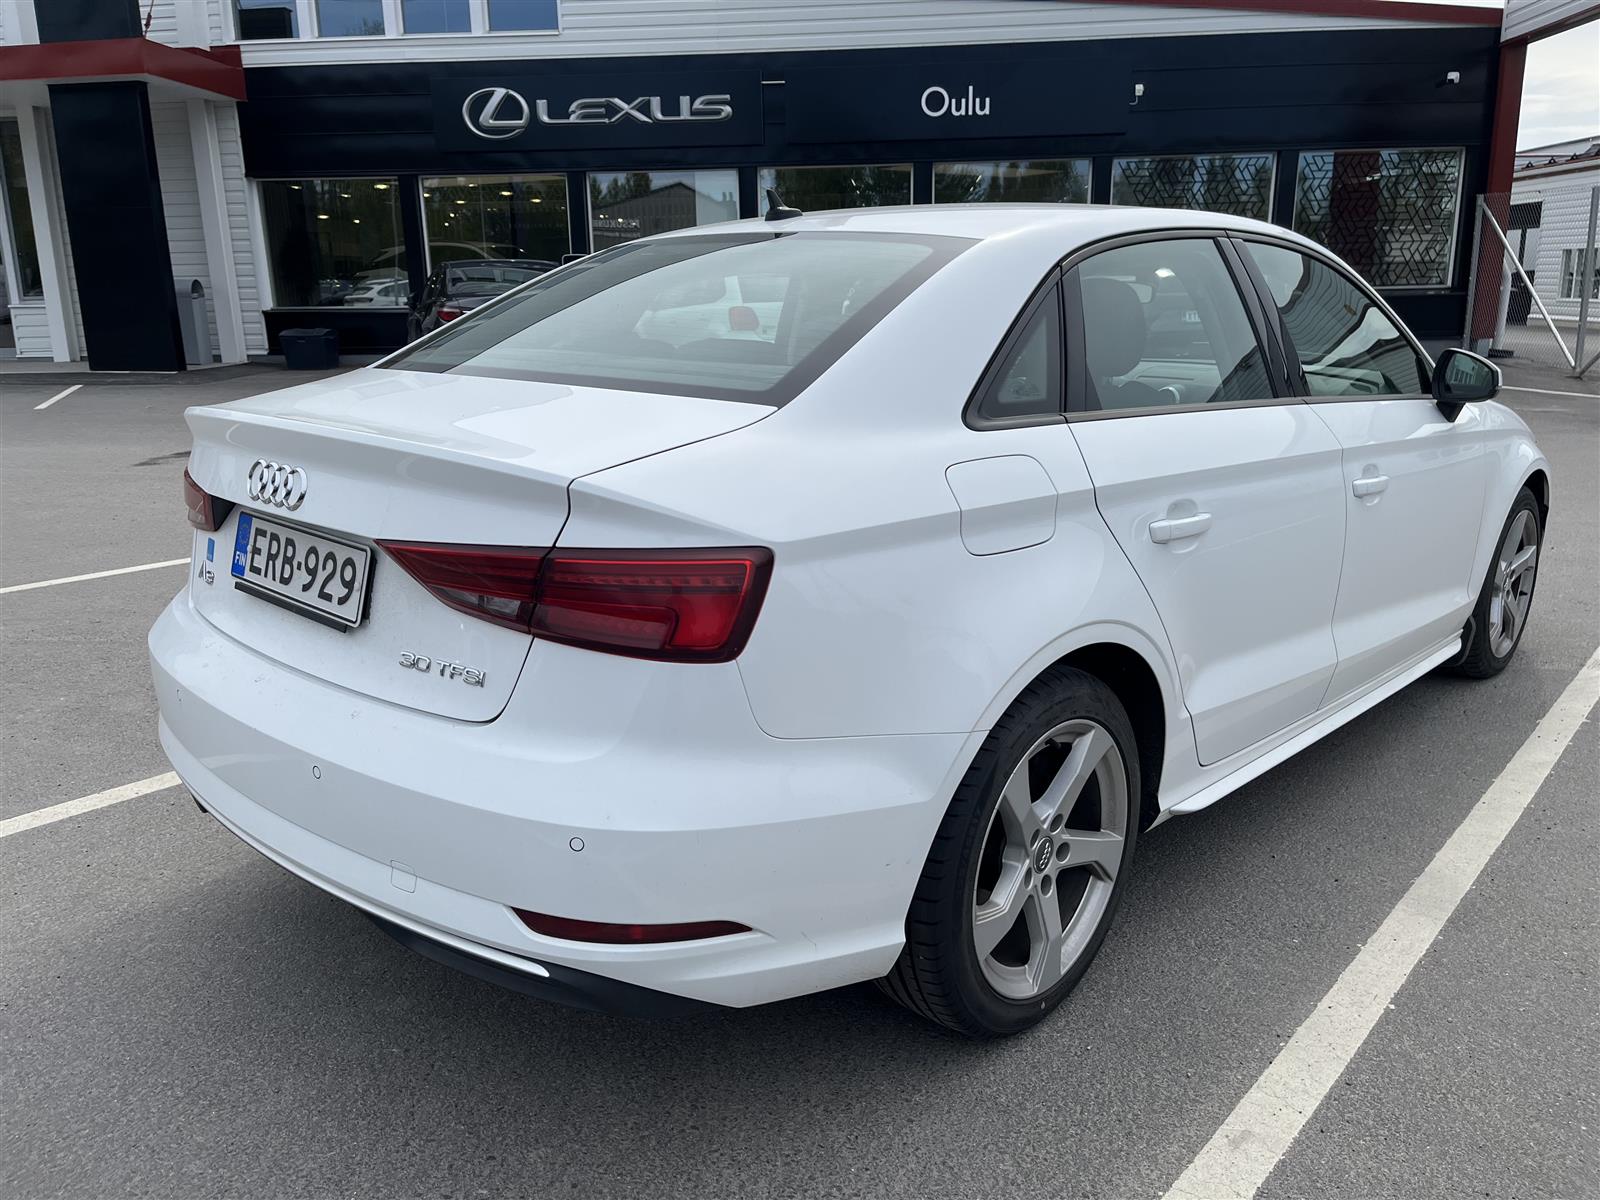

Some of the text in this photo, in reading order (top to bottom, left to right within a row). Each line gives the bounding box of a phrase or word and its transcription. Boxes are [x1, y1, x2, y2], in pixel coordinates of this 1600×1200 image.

[536, 95, 733, 124] LEXUS
[921, 85, 990, 117] Oulu
[234, 527, 357, 606] FIN ERB-929
[399, 651, 486, 688] 30 TFSI
